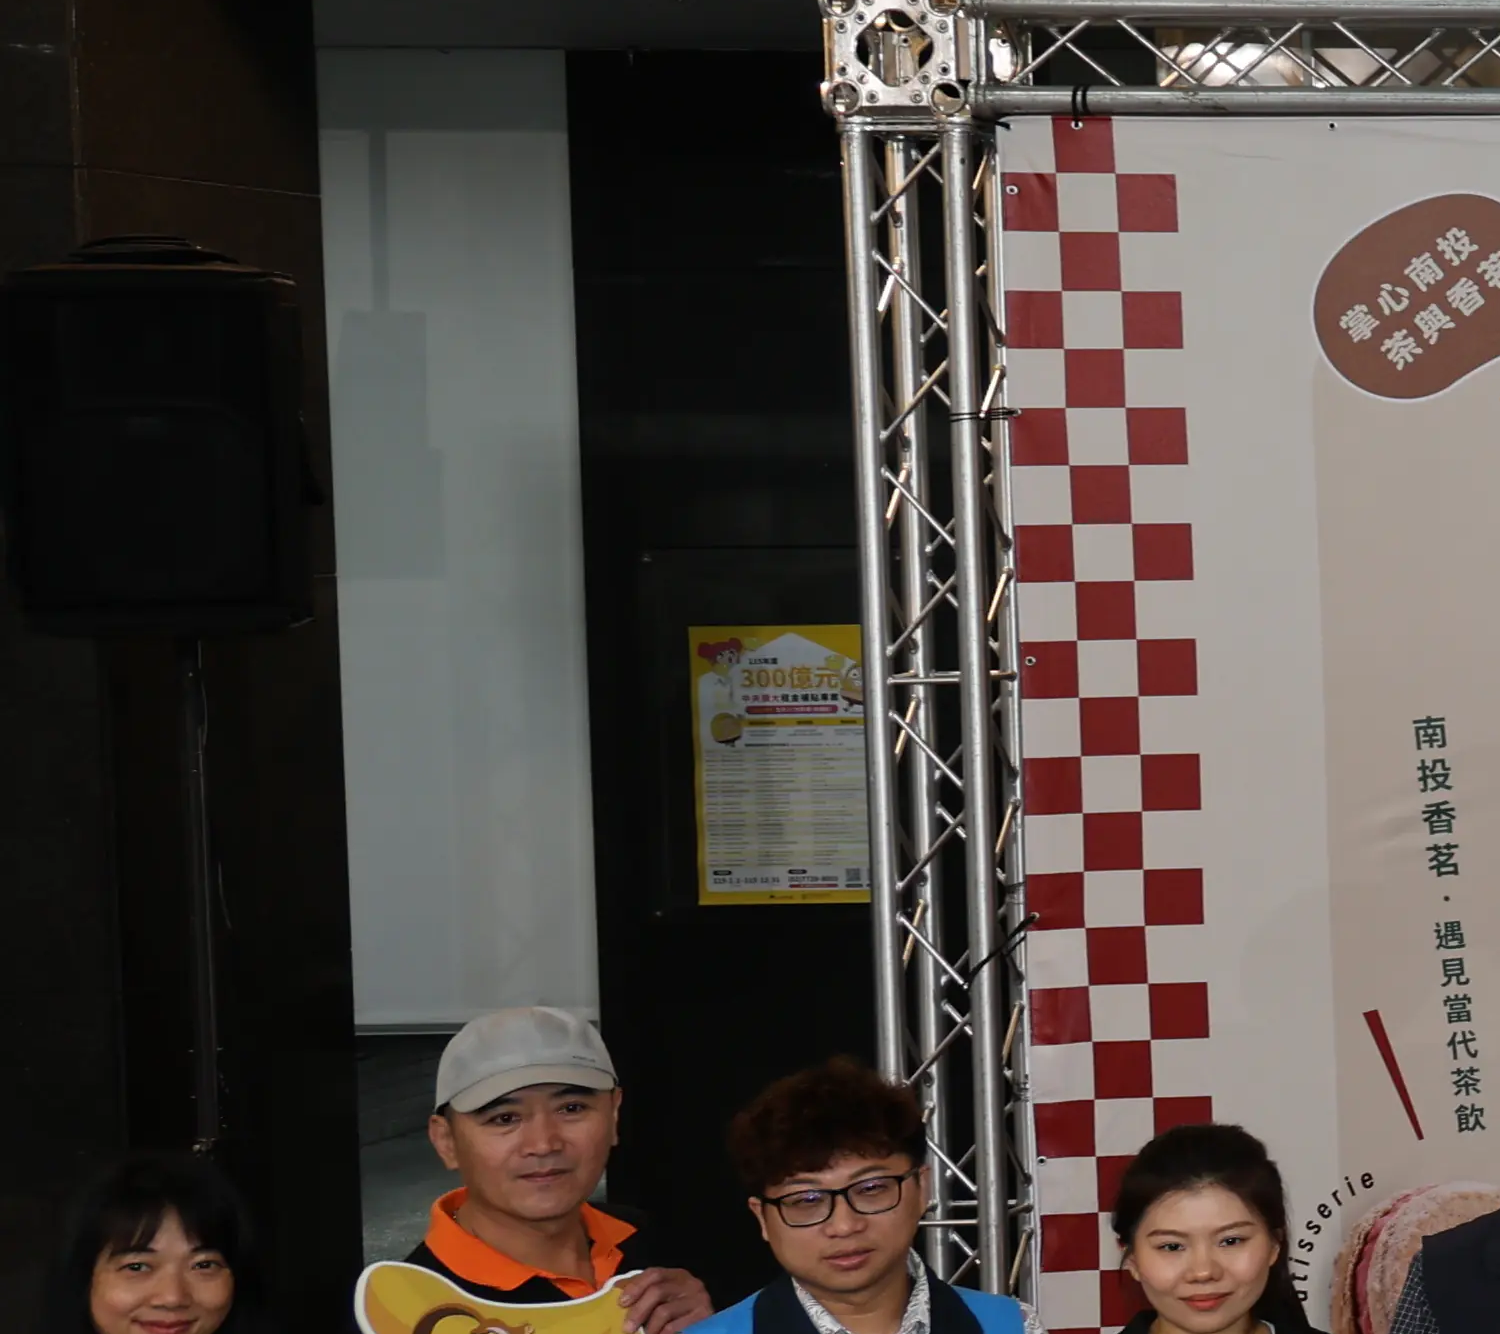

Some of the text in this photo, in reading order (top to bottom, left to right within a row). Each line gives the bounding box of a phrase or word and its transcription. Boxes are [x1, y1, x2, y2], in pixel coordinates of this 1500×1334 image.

[1338, 225, 1480, 344] 掌心南投
[1288, 1171, 1375, 1302] atisserie
